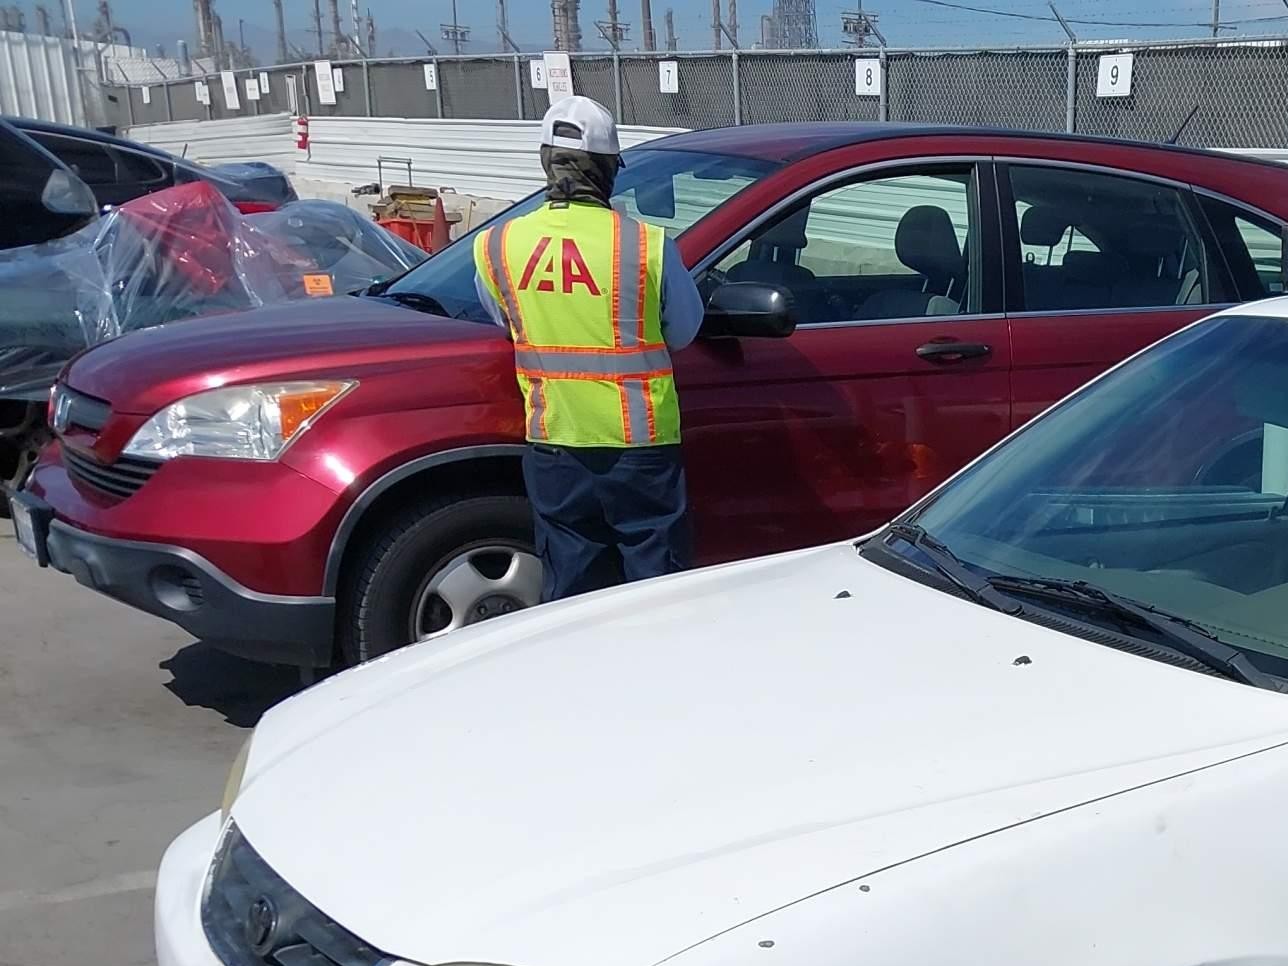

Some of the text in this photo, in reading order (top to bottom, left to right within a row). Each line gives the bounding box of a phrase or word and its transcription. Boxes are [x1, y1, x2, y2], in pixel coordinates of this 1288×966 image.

[536, 67, 542, 81] 6
[665, 69, 671, 85] 7
[865, 68, 873, 86] 8
[1110, 65, 1119, 86] 9
